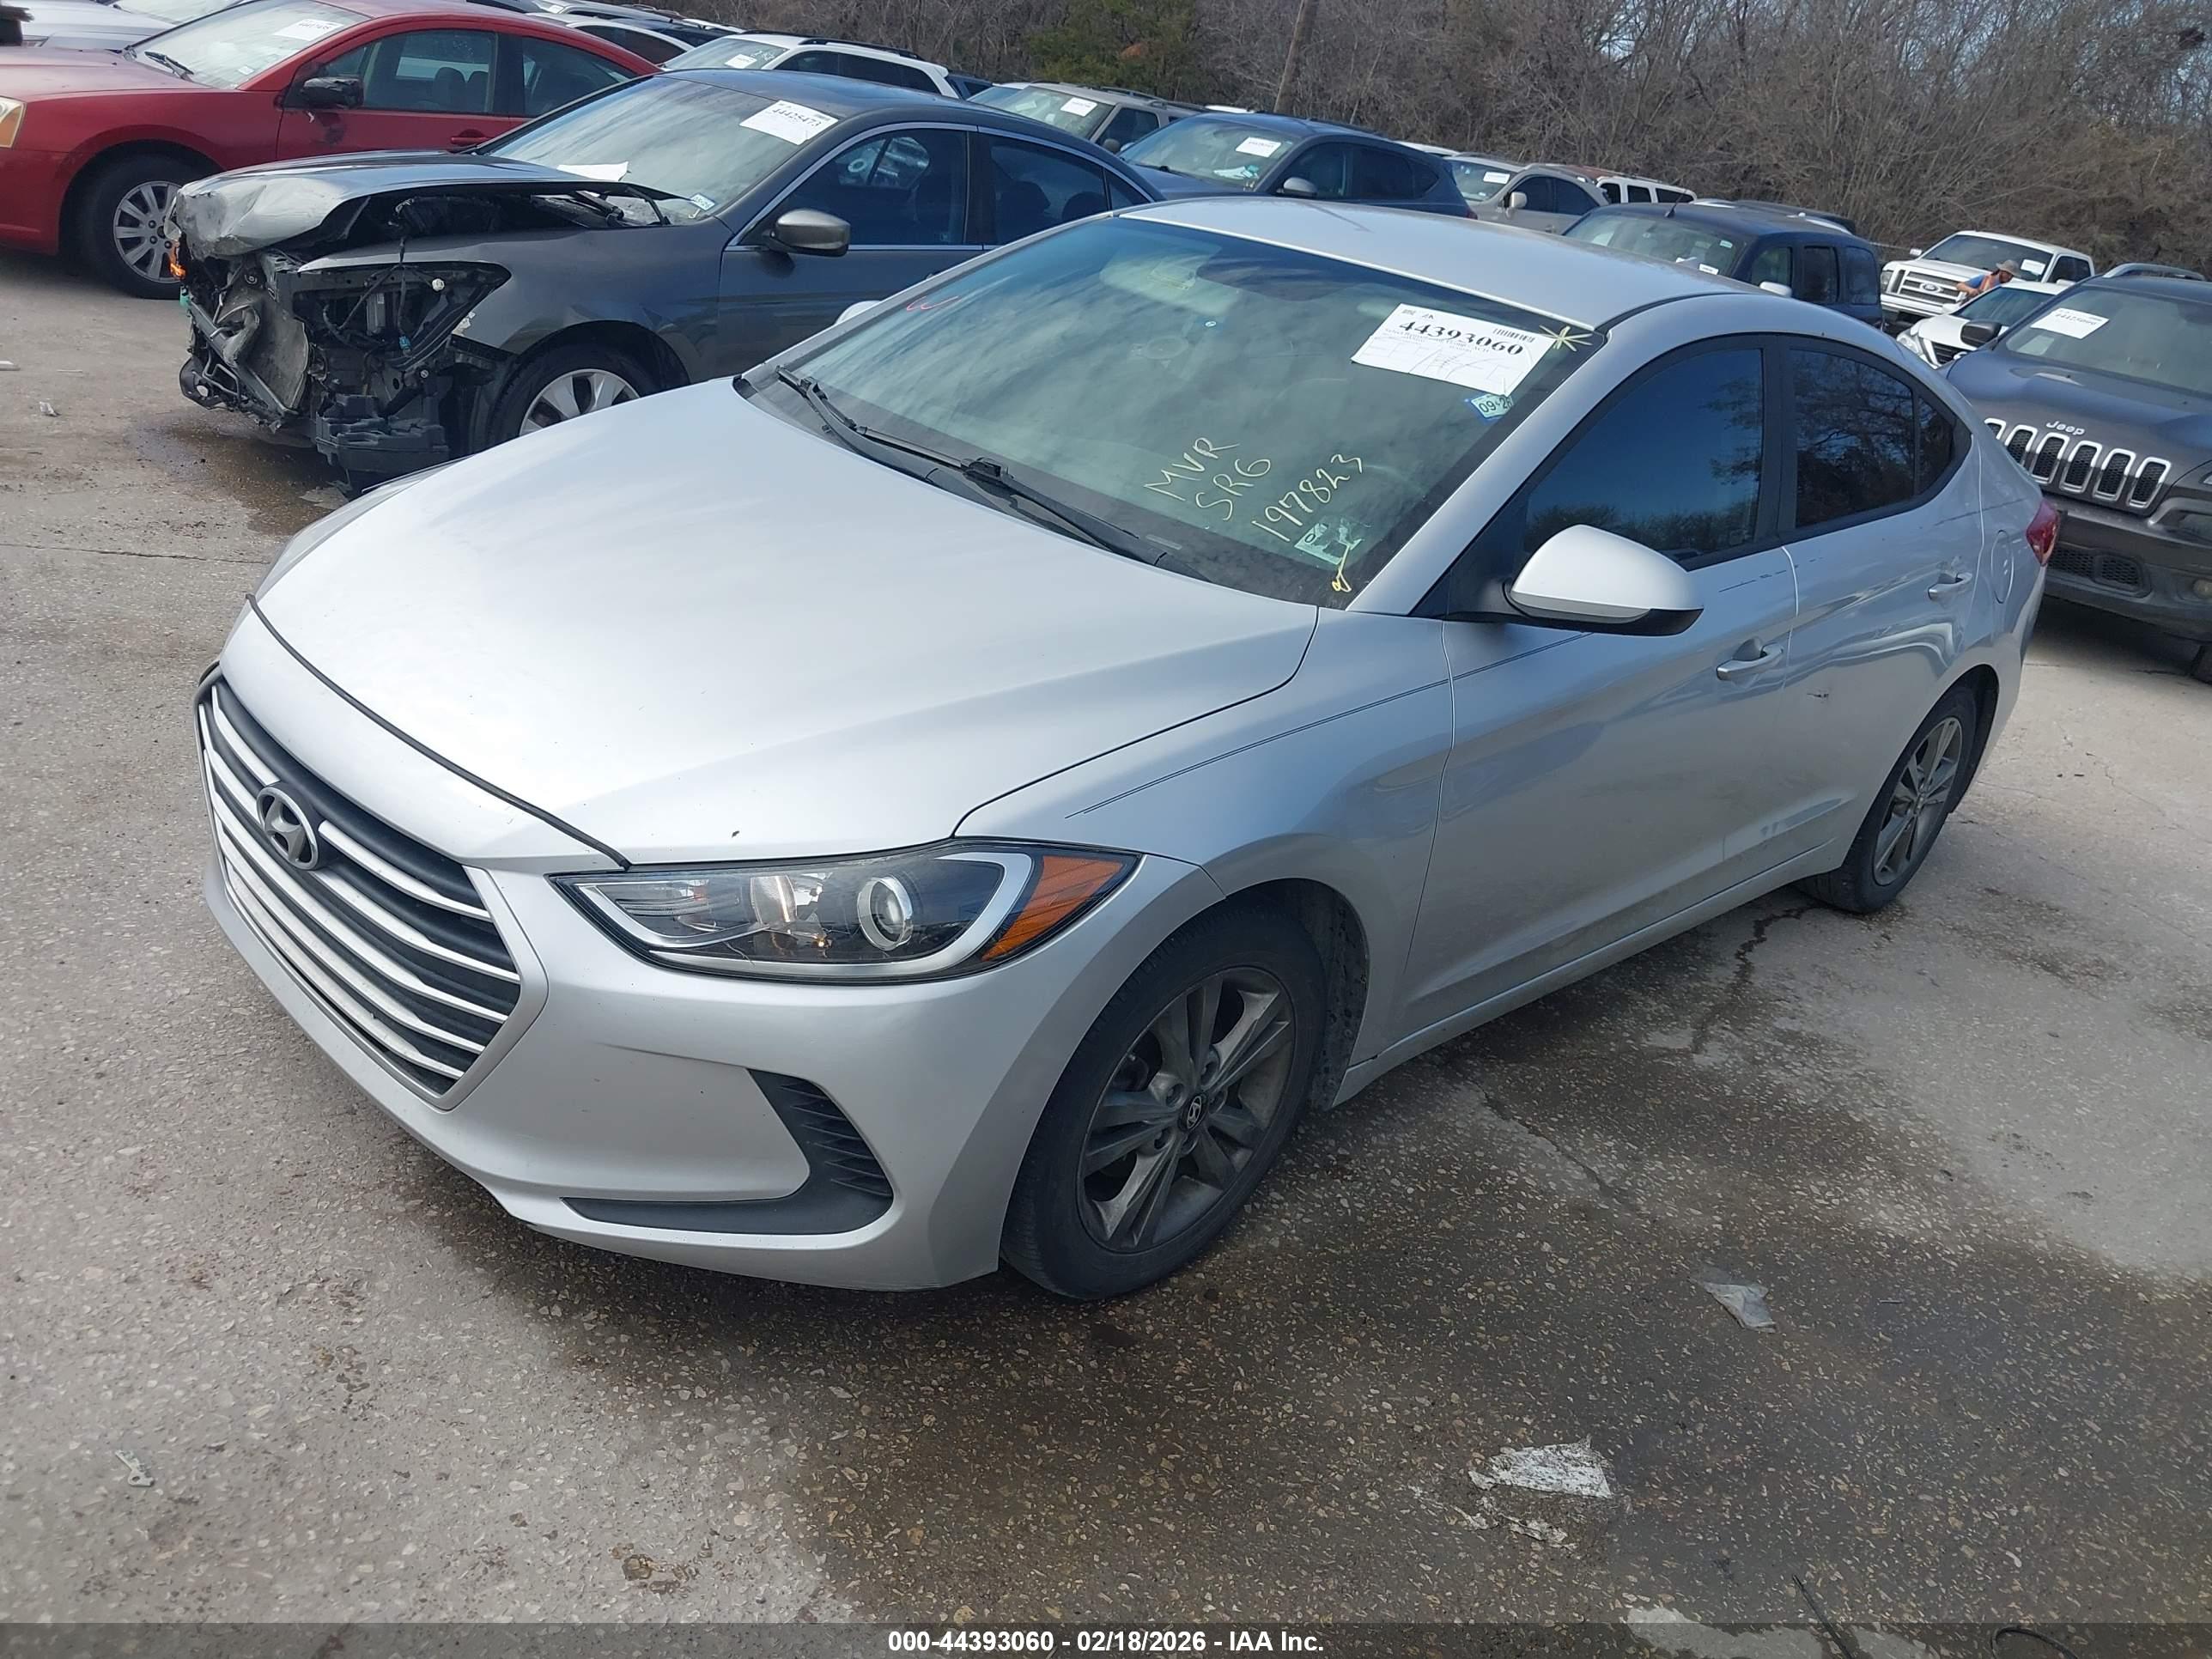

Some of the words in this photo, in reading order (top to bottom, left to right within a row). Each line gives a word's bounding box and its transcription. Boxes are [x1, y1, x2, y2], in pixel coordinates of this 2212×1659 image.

[1399, 321, 1523, 356] 44393060
[2045, 421, 2085, 435] Jeep
[1143, 437, 1240, 501] MVR
[1250, 453, 1364, 543] 197823
